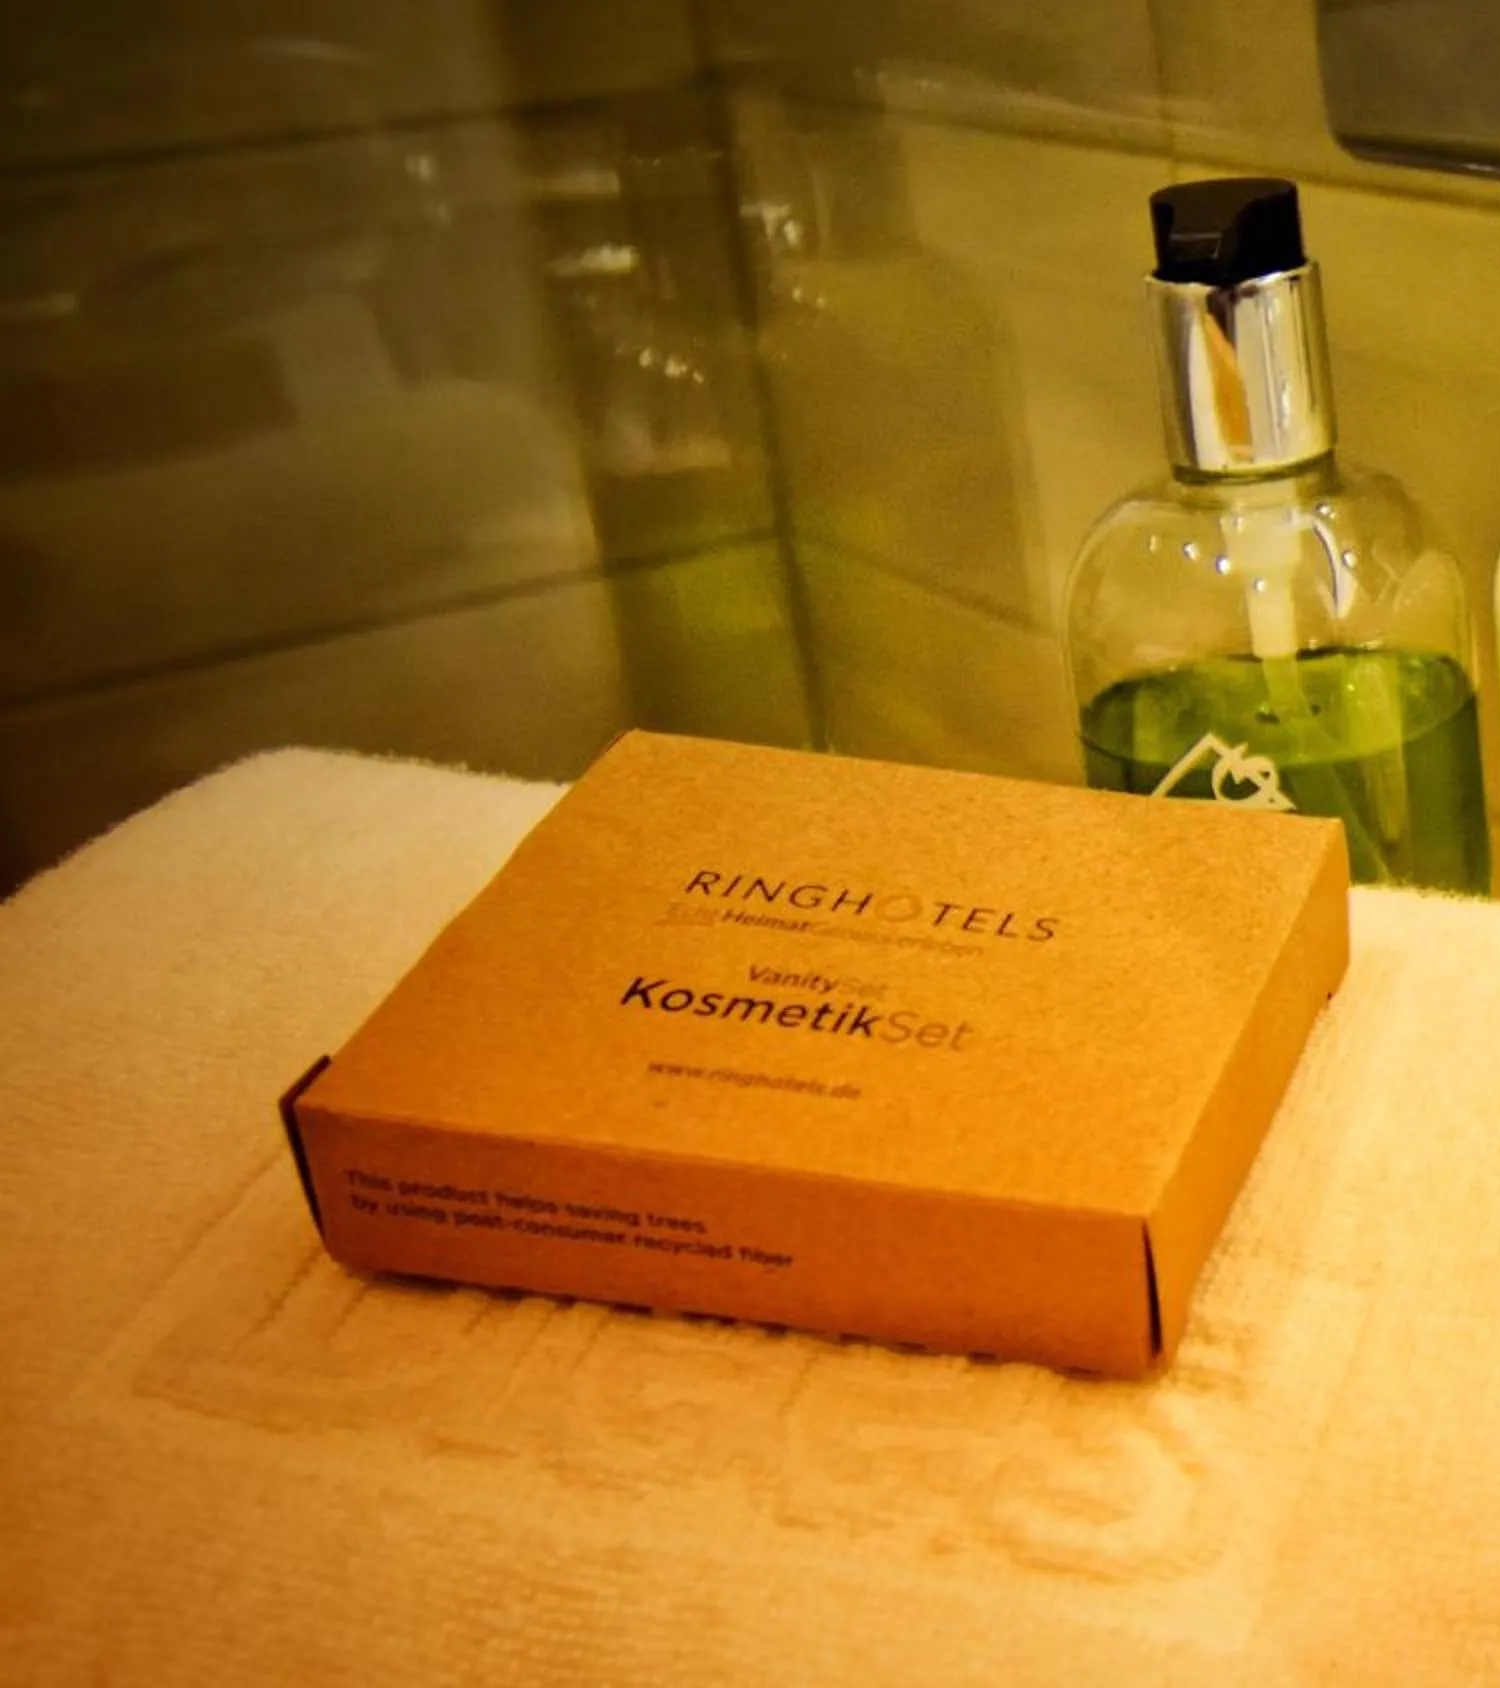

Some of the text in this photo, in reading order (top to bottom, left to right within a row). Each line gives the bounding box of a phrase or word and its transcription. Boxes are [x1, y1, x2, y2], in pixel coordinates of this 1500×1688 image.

[685, 869, 1061, 942] RINGHOTELS
[620, 976, 974, 1053] KosmetikSet
[648, 1060, 861, 1100] www.ringhotels.de
[346, 1168, 707, 1235] This product helps saving trees
[350, 1193, 793, 1269] by using post-consumer recycled fiber
